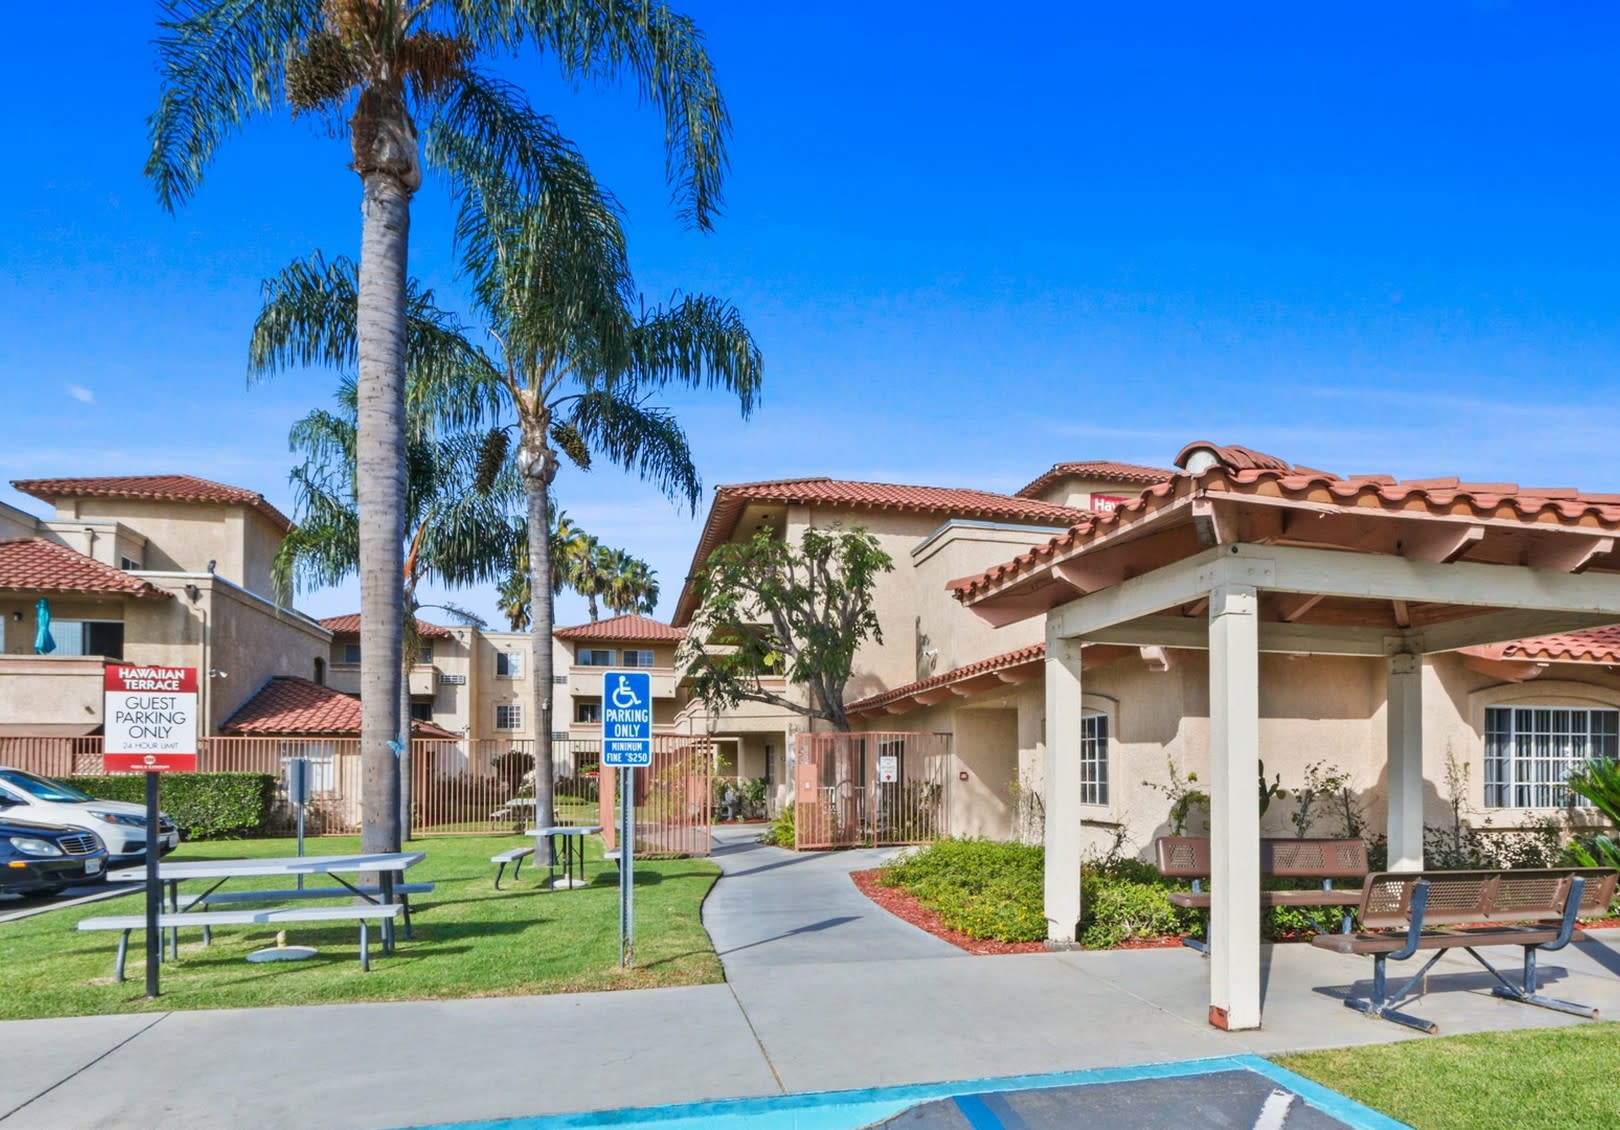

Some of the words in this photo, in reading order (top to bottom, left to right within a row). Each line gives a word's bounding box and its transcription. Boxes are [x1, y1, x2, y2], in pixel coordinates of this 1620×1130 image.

[118, 668, 185, 680] HAWAIIAN
[123, 679, 180, 691] TERRACE
[125, 696, 176, 710] GUEST
[115, 710, 186, 725] PARKING
[606, 708, 649, 723] PARKING
[128, 725, 172, 739] ONLY
[614, 723, 640, 738] ONLY
[135, 742, 159, 750] HOUR
[160, 742, 179, 750] LIMIT
[611, 742, 643, 752] MINIMUM
[606, 752, 622, 763] FINE
